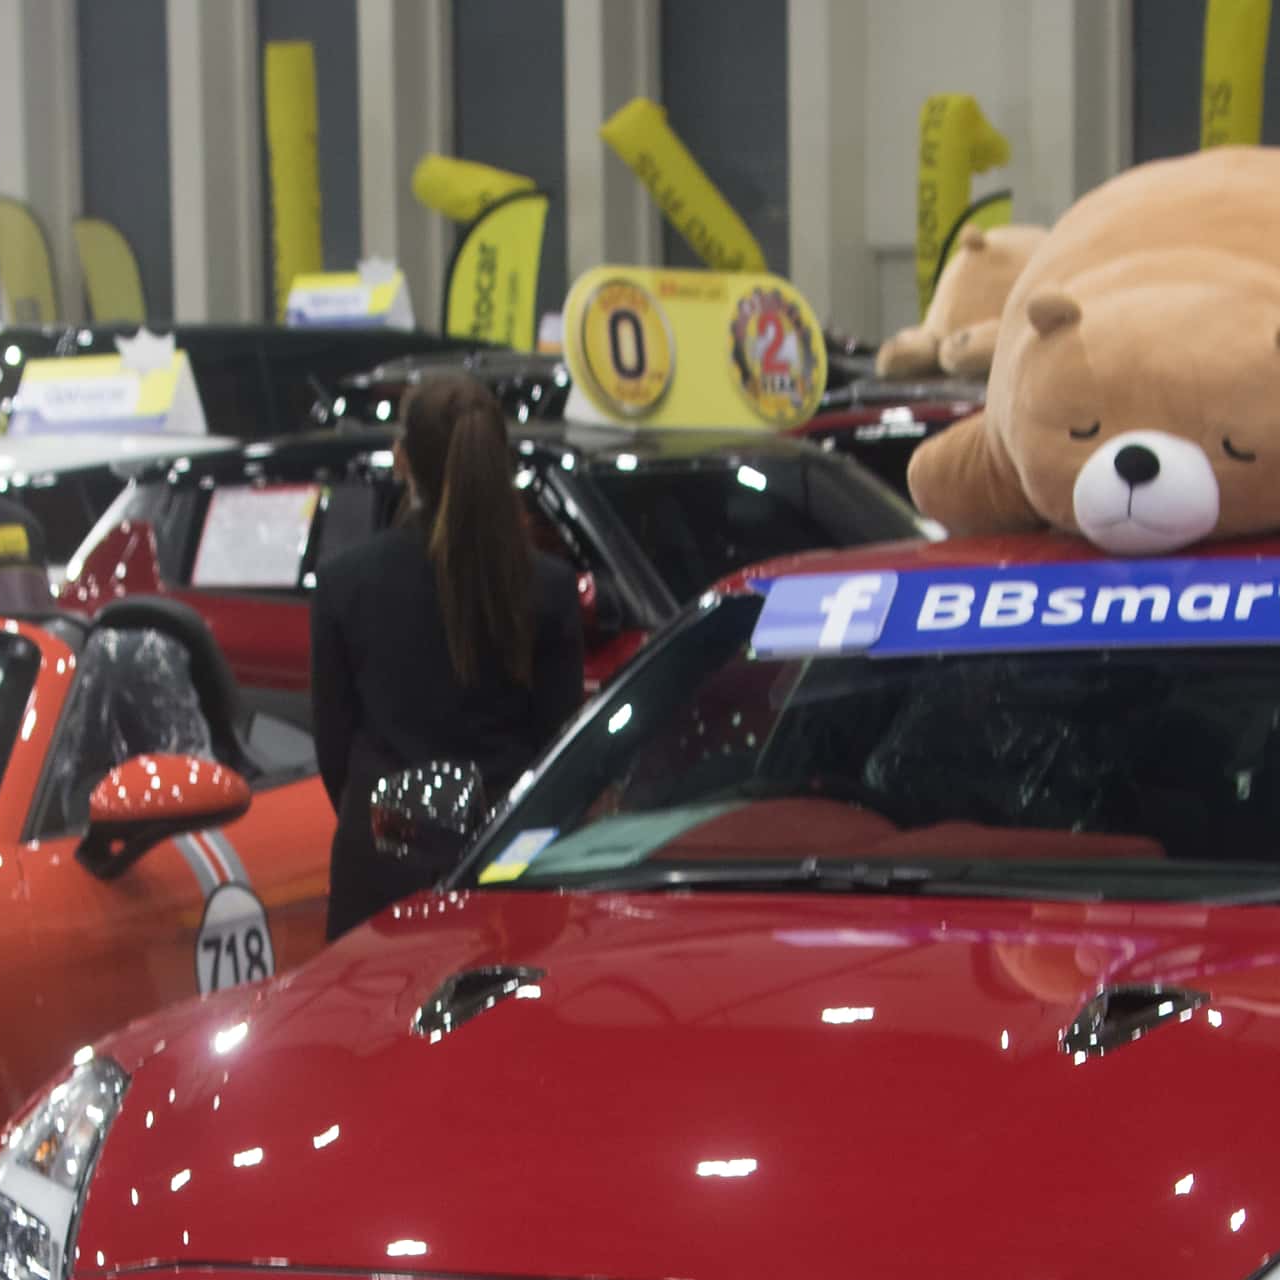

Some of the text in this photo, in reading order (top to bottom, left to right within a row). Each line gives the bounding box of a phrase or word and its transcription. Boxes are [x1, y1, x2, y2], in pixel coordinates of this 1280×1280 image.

[608, 308, 790, 381] 0 2
[202, 928, 269, 991] 718
